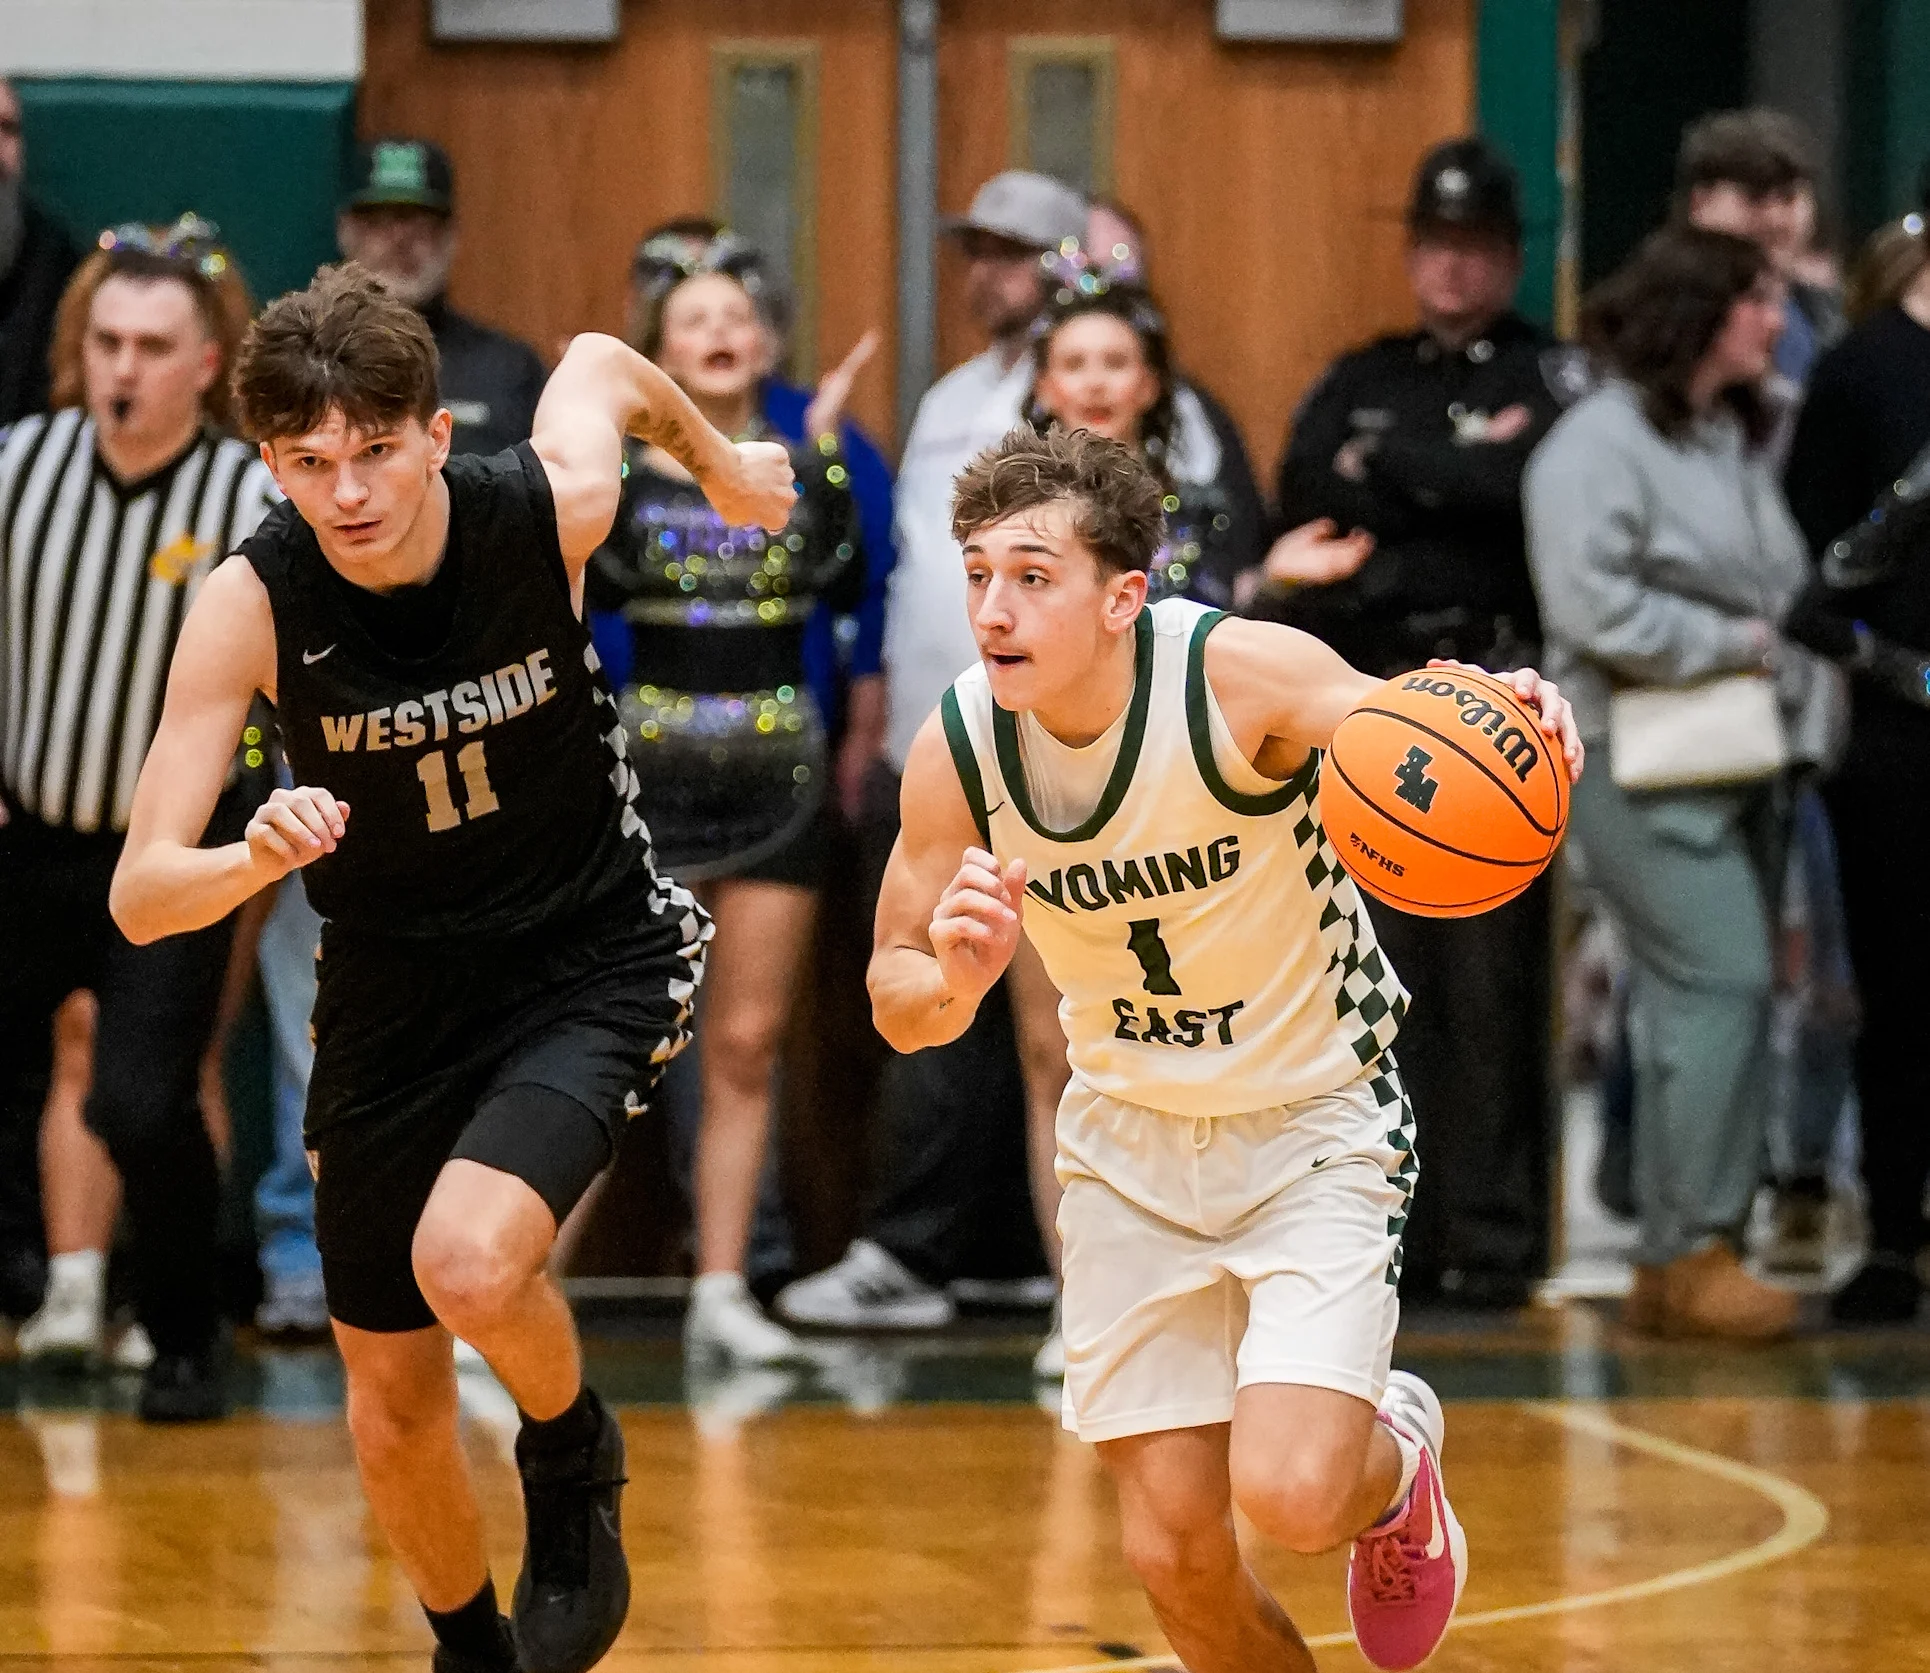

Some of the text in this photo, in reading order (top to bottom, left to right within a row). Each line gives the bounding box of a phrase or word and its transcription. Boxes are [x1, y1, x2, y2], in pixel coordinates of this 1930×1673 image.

[320, 648, 558, 753] WESTSIDE
[1401, 676, 1539, 784] Wilson
[415, 740, 500, 834] 11
[1023, 835, 1241, 914] YOMING
[1359, 841, 1406, 878] NFHS
[1126, 917, 1183, 996] 1
[1111, 997, 1245, 1048] EAST
